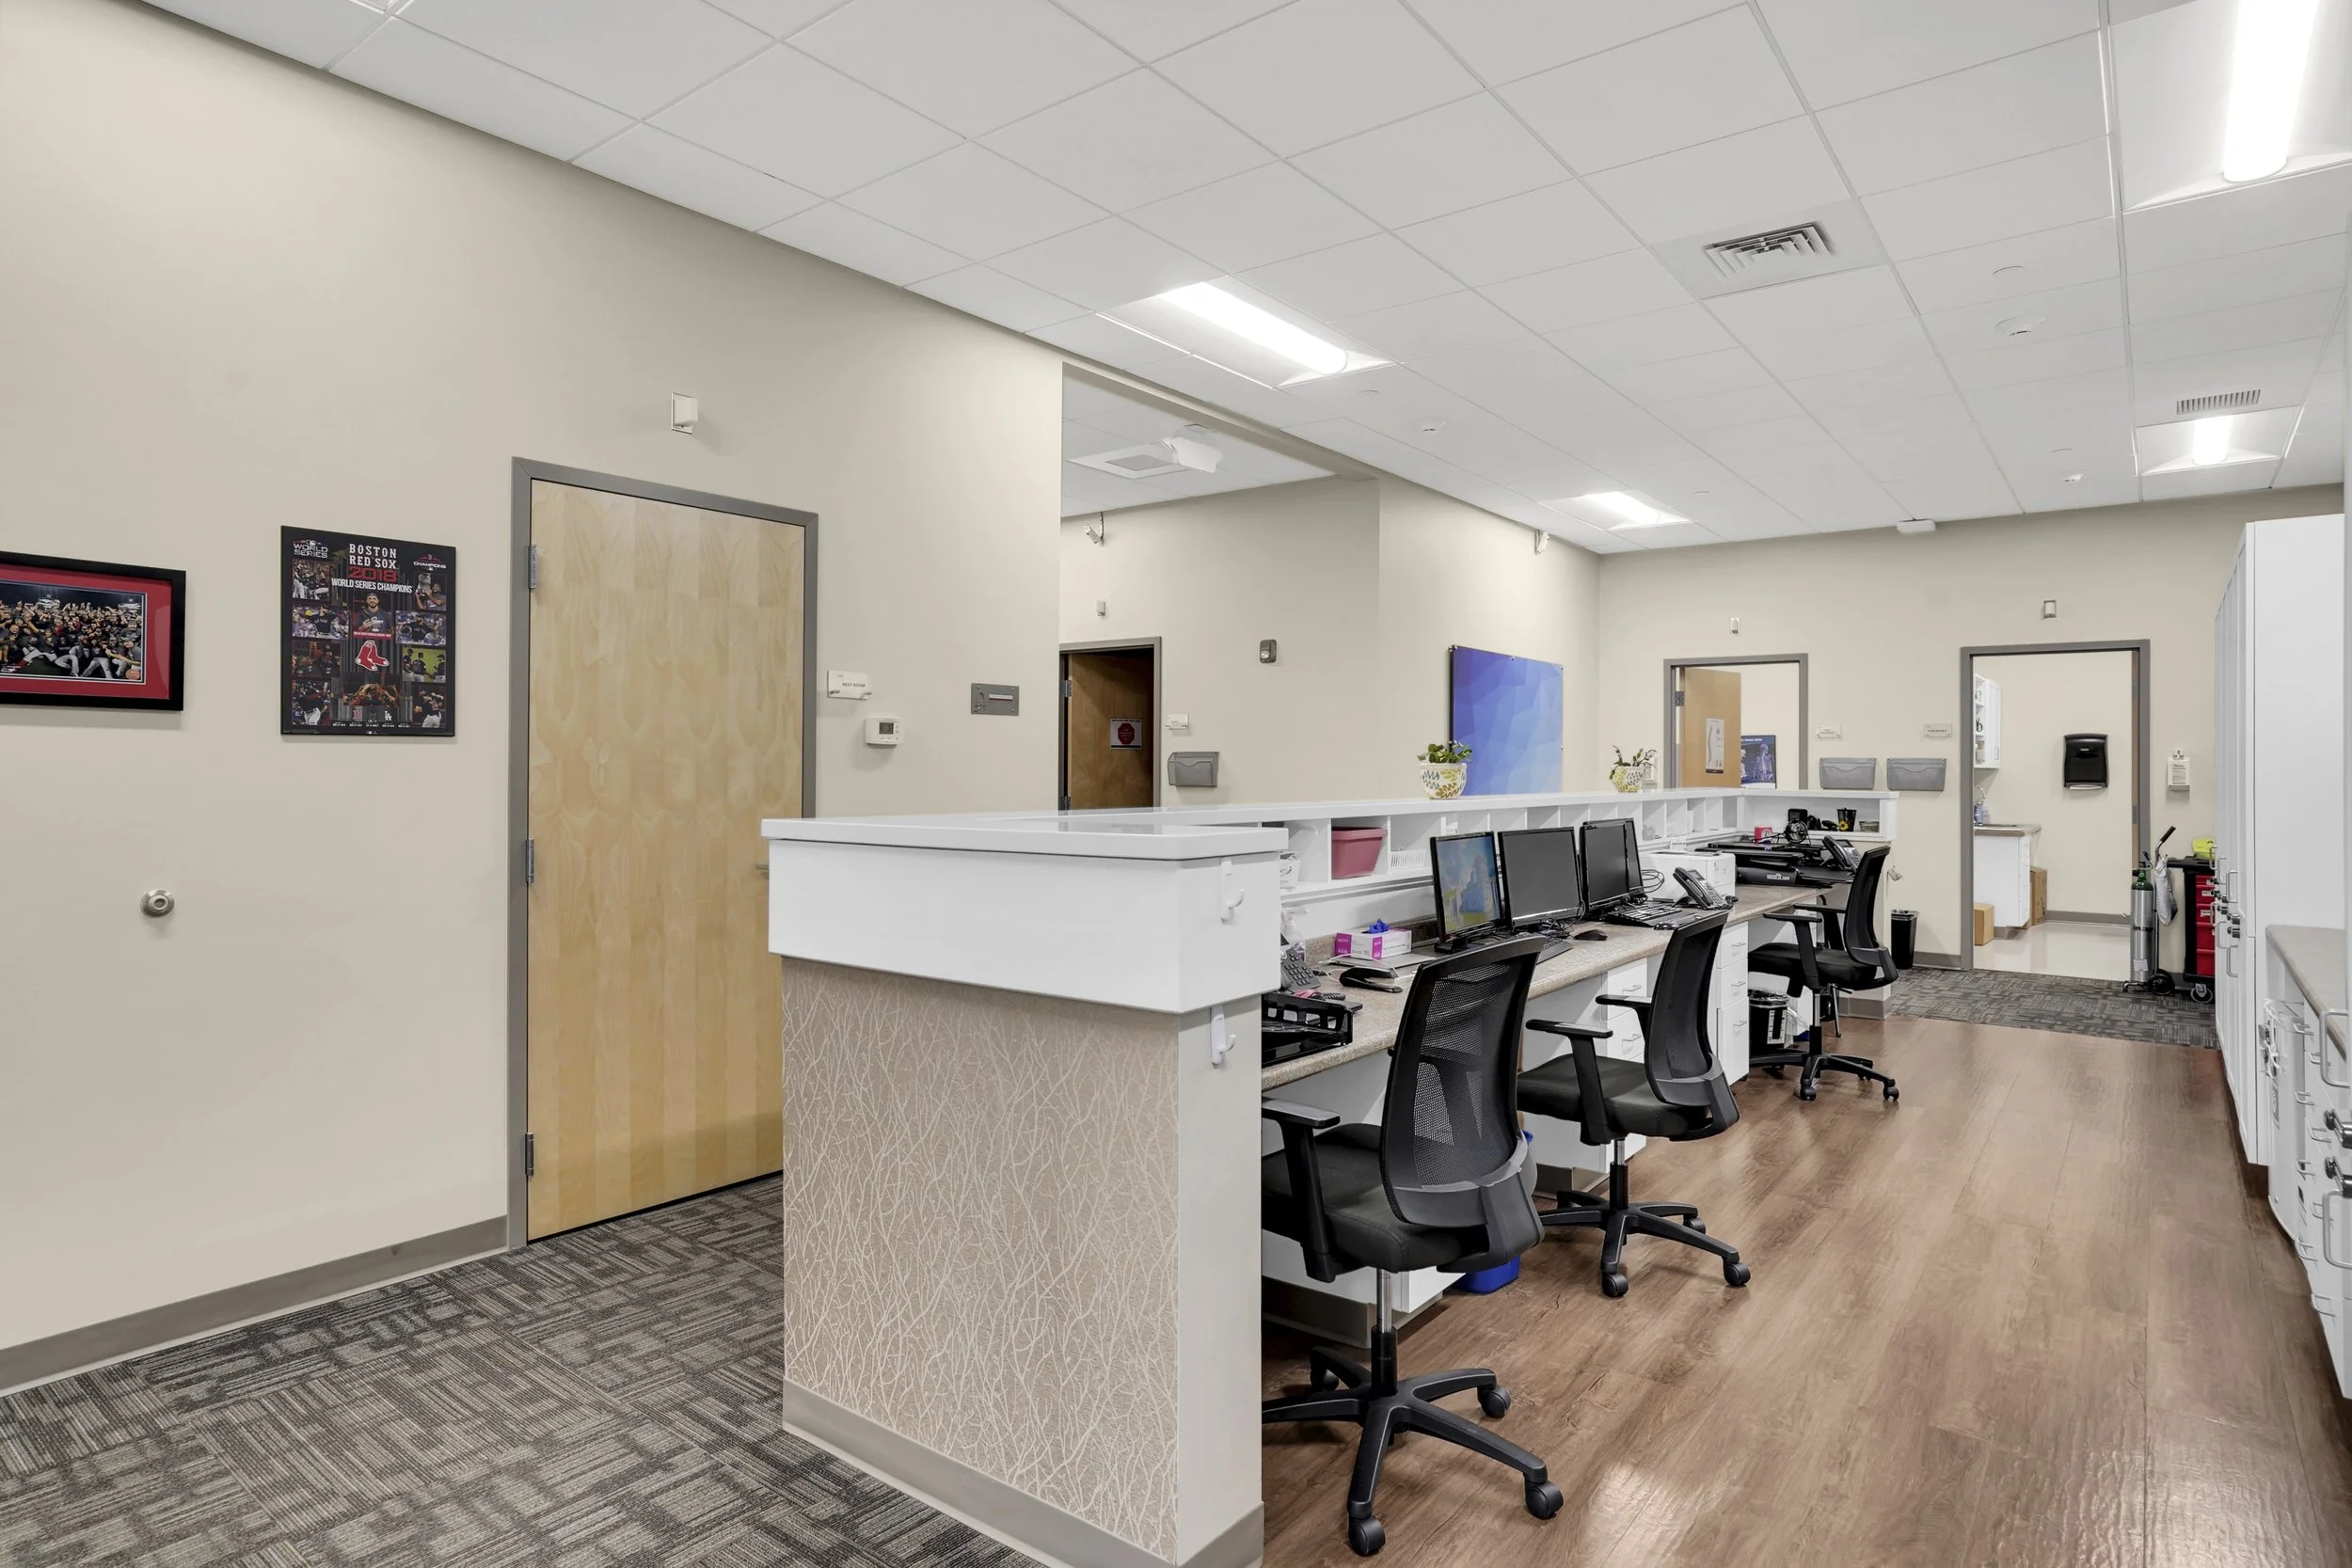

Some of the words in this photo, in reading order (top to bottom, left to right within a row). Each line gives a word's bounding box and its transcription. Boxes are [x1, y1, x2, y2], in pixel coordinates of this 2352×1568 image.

[293, 543, 328, 552] WORLD
[294, 549, 328, 558] SERIES
[349, 543, 397, 558] BOSTON
[349, 555, 371, 566] RED
[374, 558, 397, 570] SOX
[348, 565, 399, 582] 2018
[331, 578, 355, 588] WORLD
[355, 579, 376, 590] SERIES
[377, 582, 413, 594] CHAMPIONS
